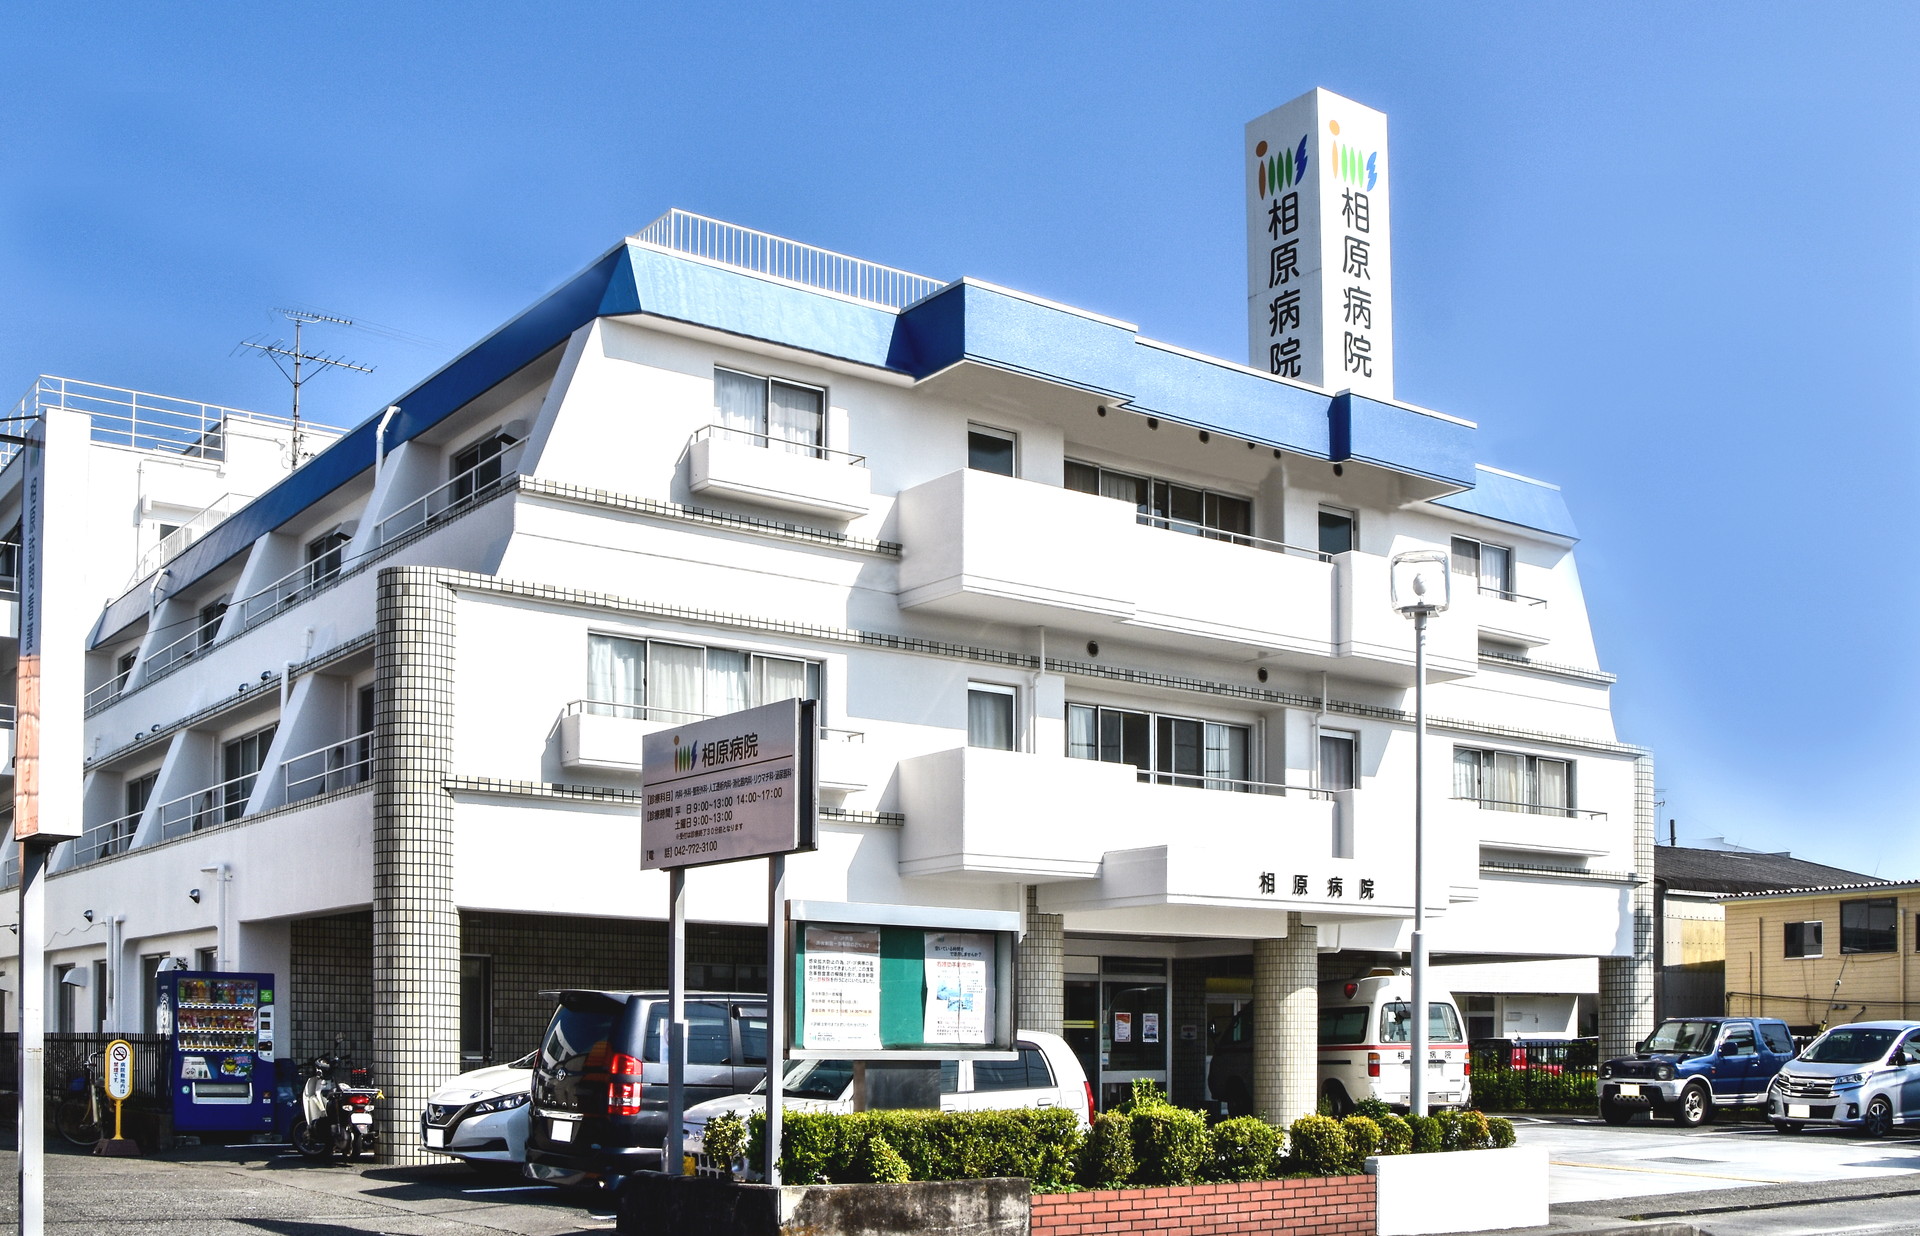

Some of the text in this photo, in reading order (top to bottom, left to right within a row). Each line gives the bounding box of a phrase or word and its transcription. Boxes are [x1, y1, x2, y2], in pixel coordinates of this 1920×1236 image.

[1268, 191, 1302, 378] 相原病院
[1341, 187, 1372, 378] 相原病院
[702, 732, 758, 768] 相原病院
[674, 841, 717, 857] 042-772-3100
[1259, 871, 1374, 900] 相原病院
[1397, 1050, 1452, 1060] 相病院
